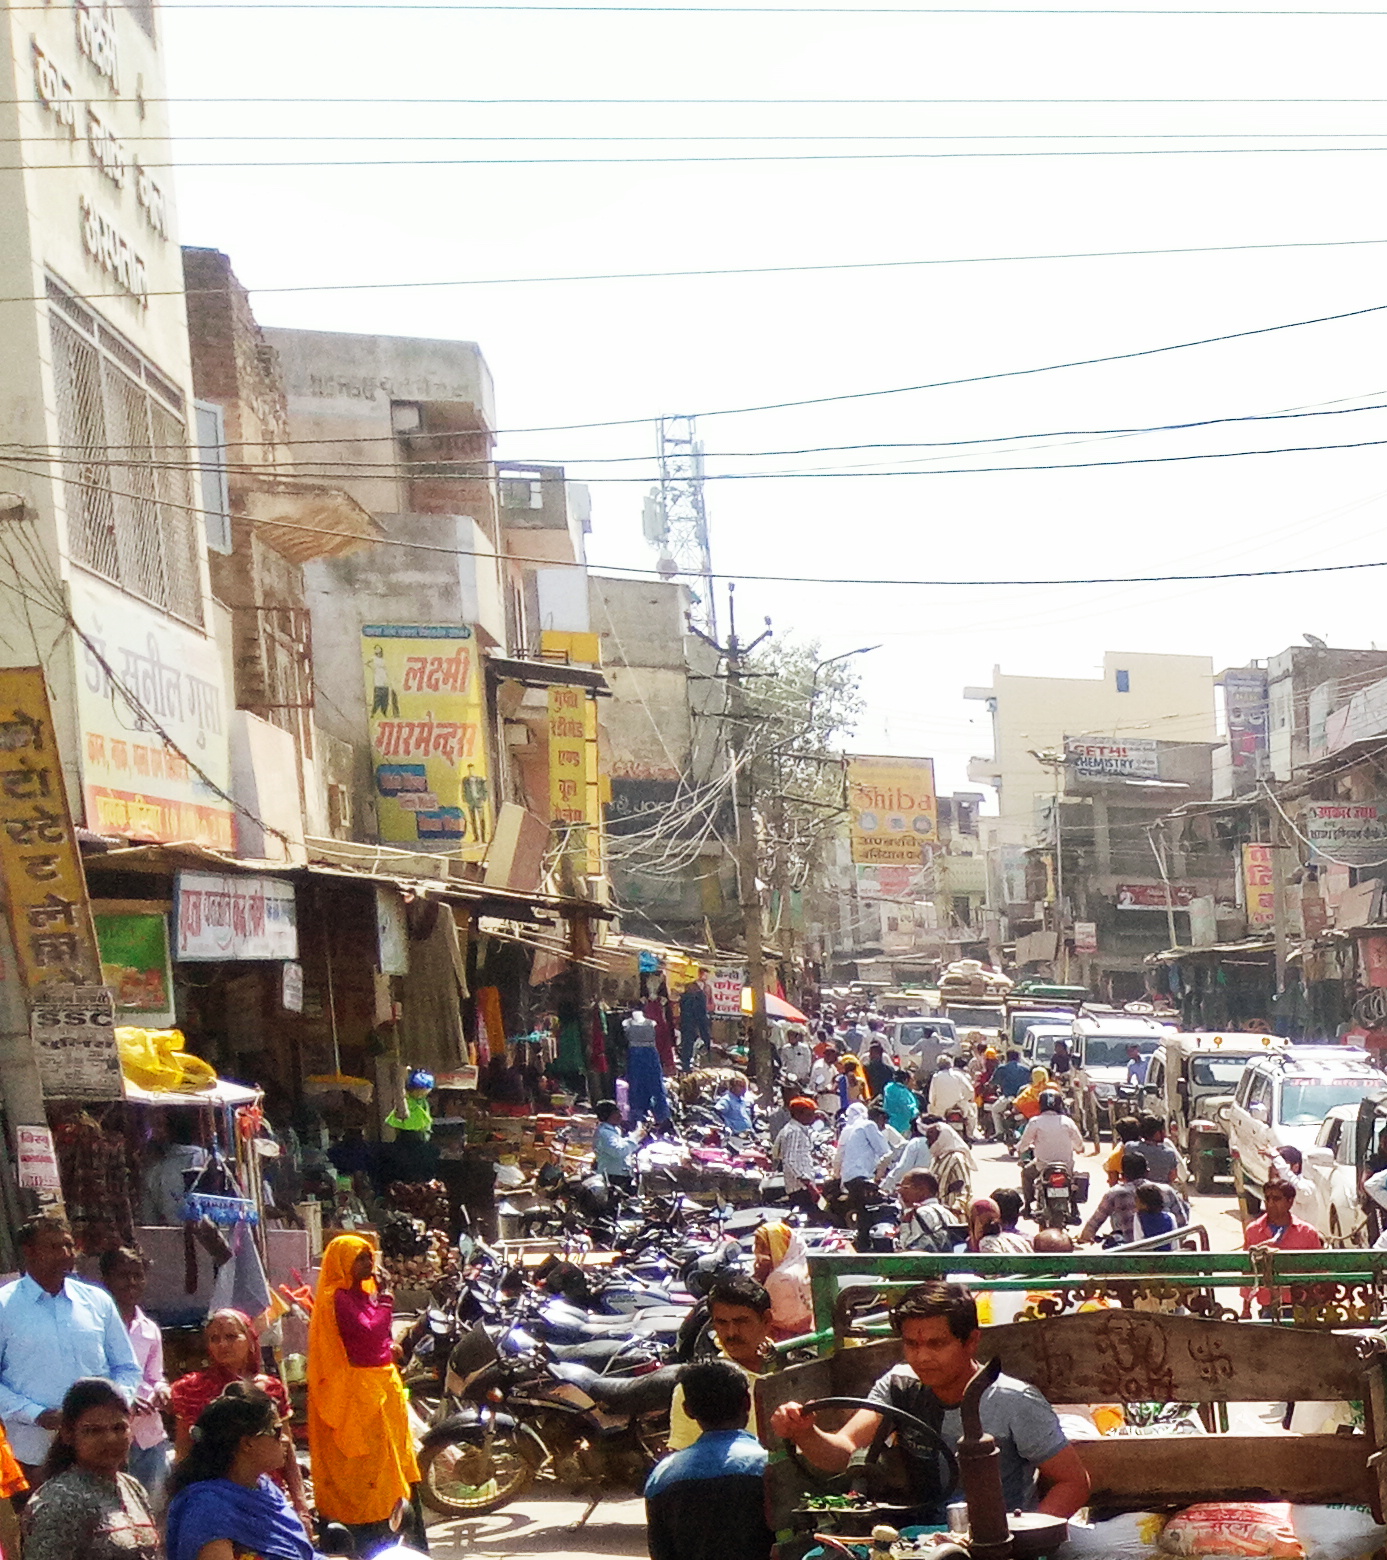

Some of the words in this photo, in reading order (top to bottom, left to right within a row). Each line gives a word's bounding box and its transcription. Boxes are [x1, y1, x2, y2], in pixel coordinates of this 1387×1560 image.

[403, 646, 471, 692] लक्ष्मी
[853, 786, 932, 811] Shiba
[37, 1011, 113, 1028] SSC
